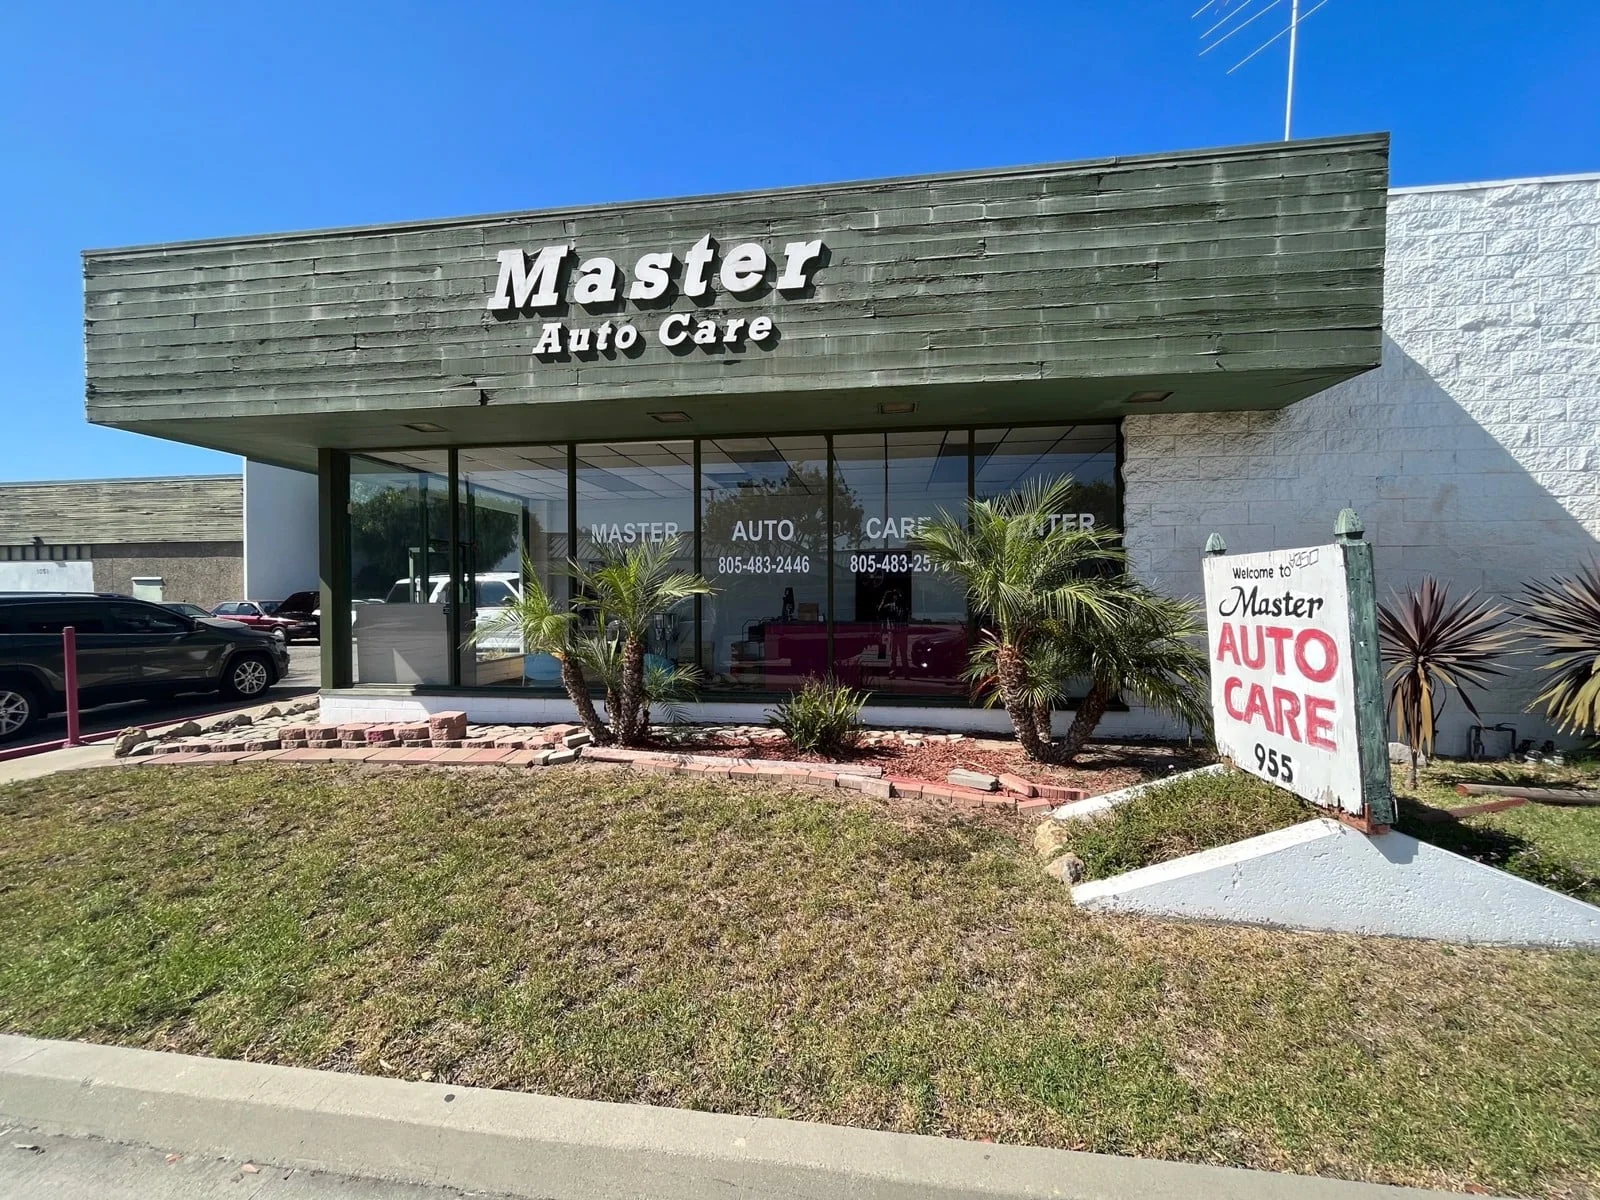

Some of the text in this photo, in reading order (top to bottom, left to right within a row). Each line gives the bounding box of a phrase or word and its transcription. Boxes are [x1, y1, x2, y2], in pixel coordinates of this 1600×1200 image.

[487, 233, 822, 310] Master
[532, 313, 773, 354] Auto Care
[591, 522, 678, 544] MASTER
[732, 519, 795, 541] AUTO
[718, 555, 810, 574] 805-483-2446
[1232, 564, 1292, 579] Welcome to
[1219, 585, 1324, 619] Master
[1216, 622, 1339, 683] AUTO
[1224, 676, 1337, 751] CARE
[1254, 743, 1294, 783] 955
